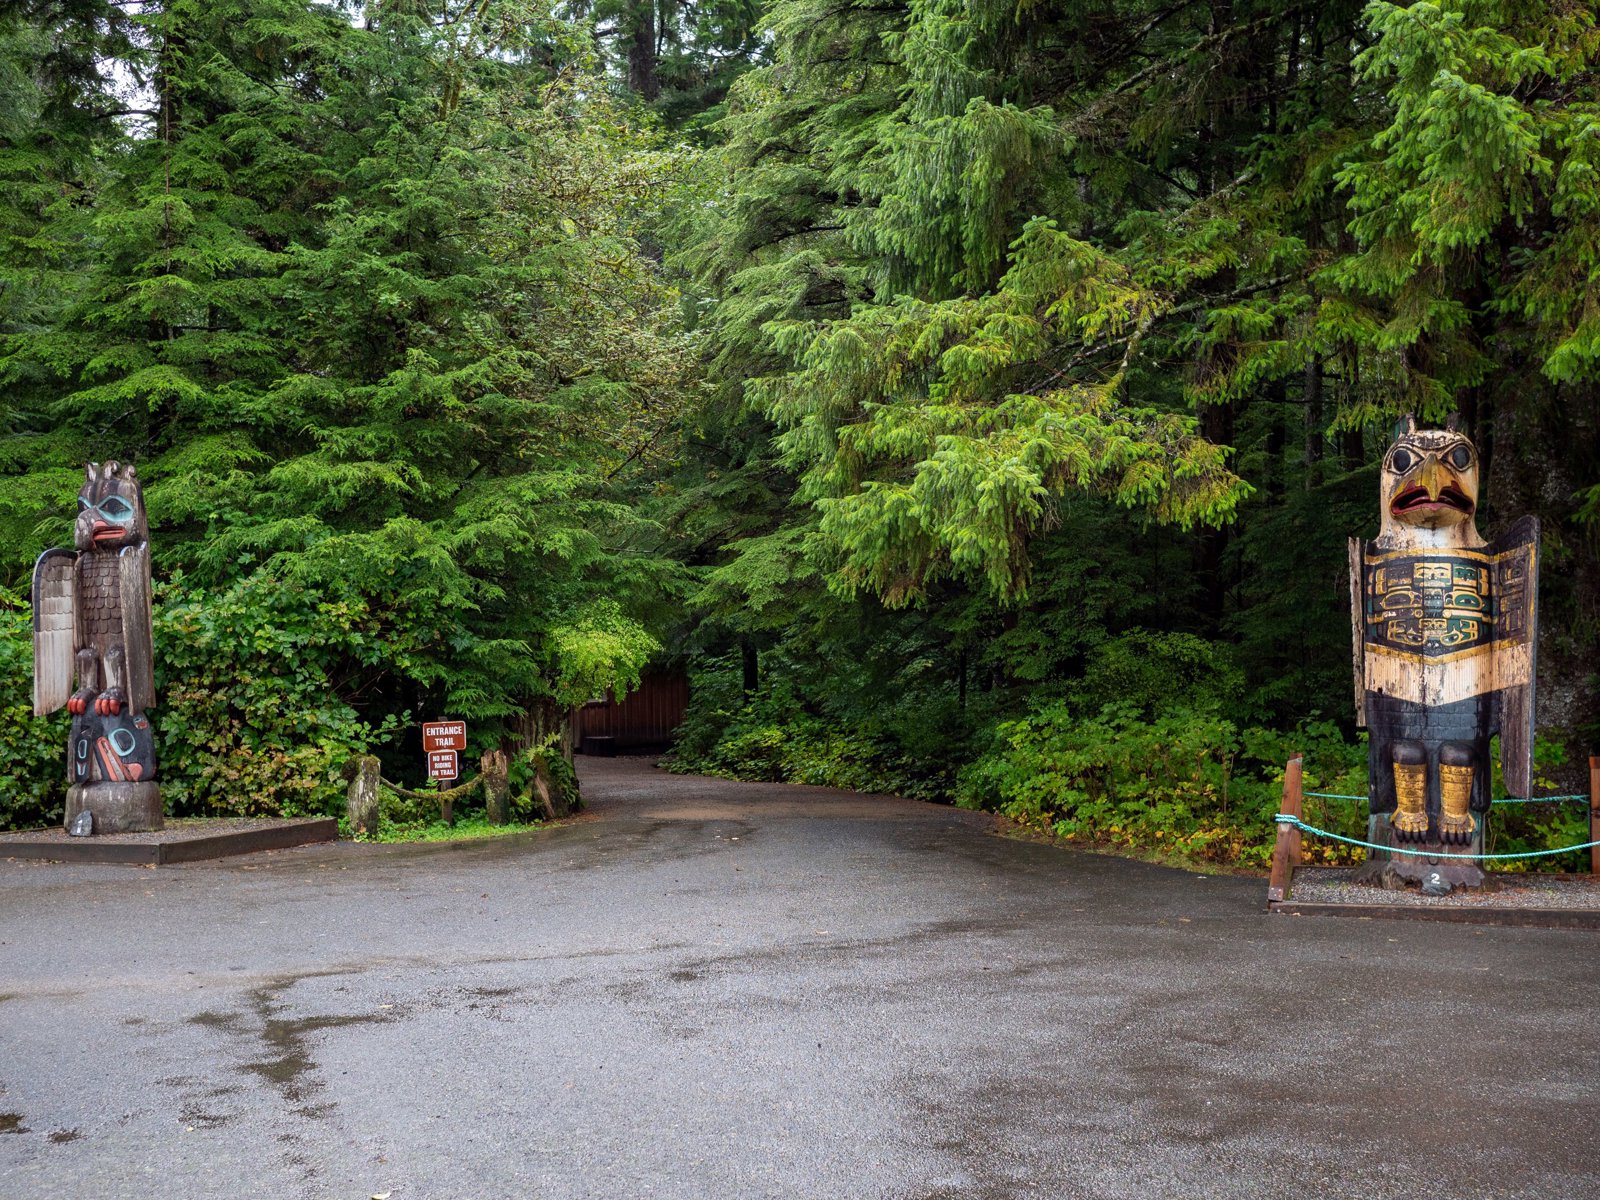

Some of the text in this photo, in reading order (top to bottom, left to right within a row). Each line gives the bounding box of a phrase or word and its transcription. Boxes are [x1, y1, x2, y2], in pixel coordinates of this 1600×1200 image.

[426, 726, 463, 736] ENTRANCE
[435, 738, 455, 746] TRAIL
[77, 820, 83, 833] 1
[1431, 873, 1441, 885] 2
